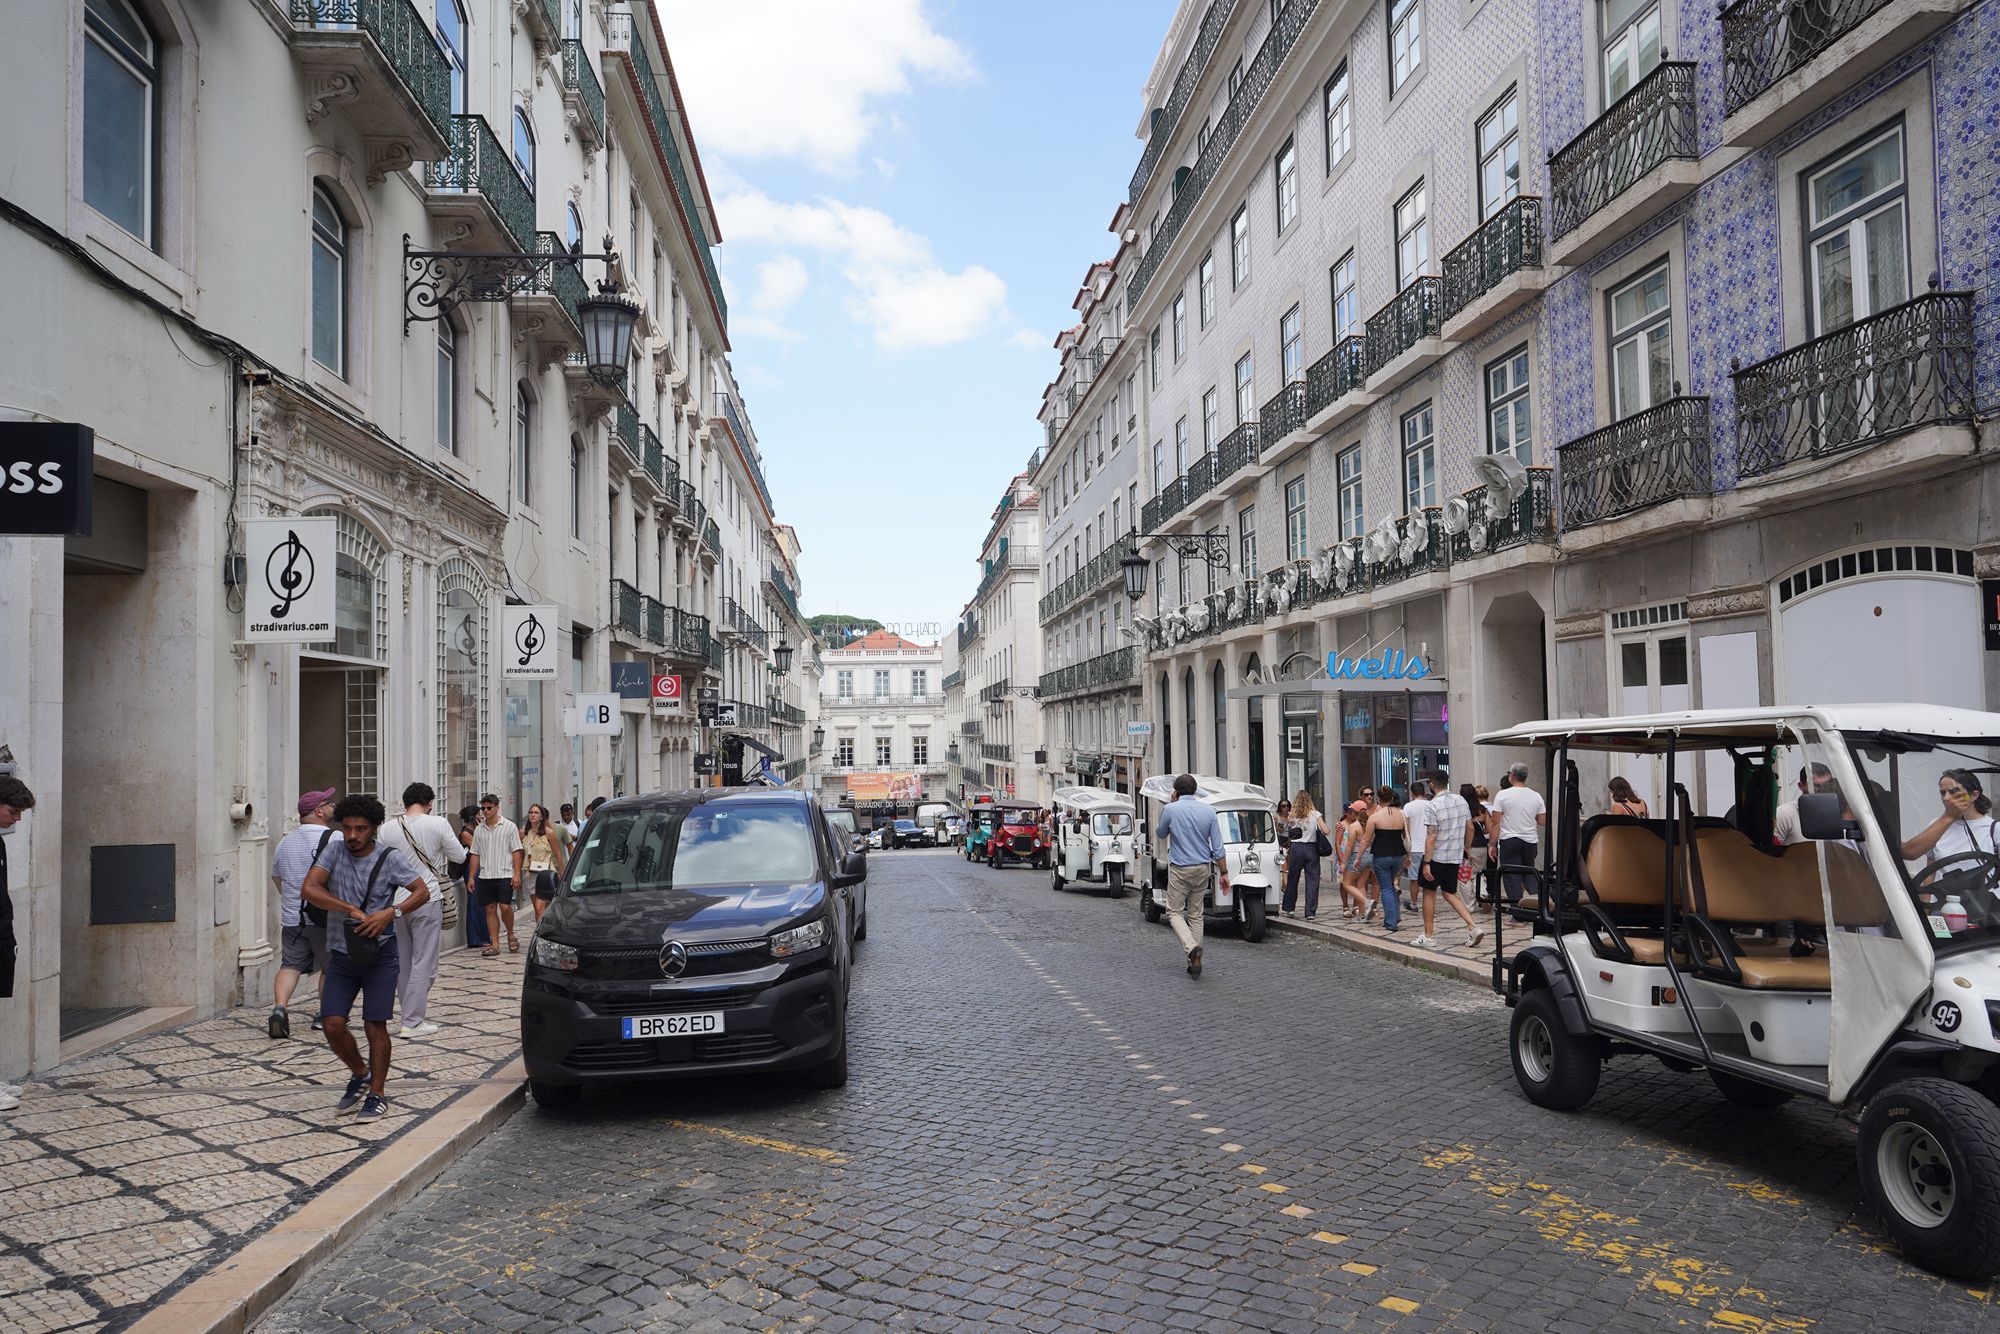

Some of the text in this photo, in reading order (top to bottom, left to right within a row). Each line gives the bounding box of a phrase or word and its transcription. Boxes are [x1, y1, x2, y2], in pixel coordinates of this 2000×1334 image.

[0, 461, 63, 494] SS
[250, 622, 329, 632] stradivarius.com
[1935, 1005, 1959, 1028] 95
